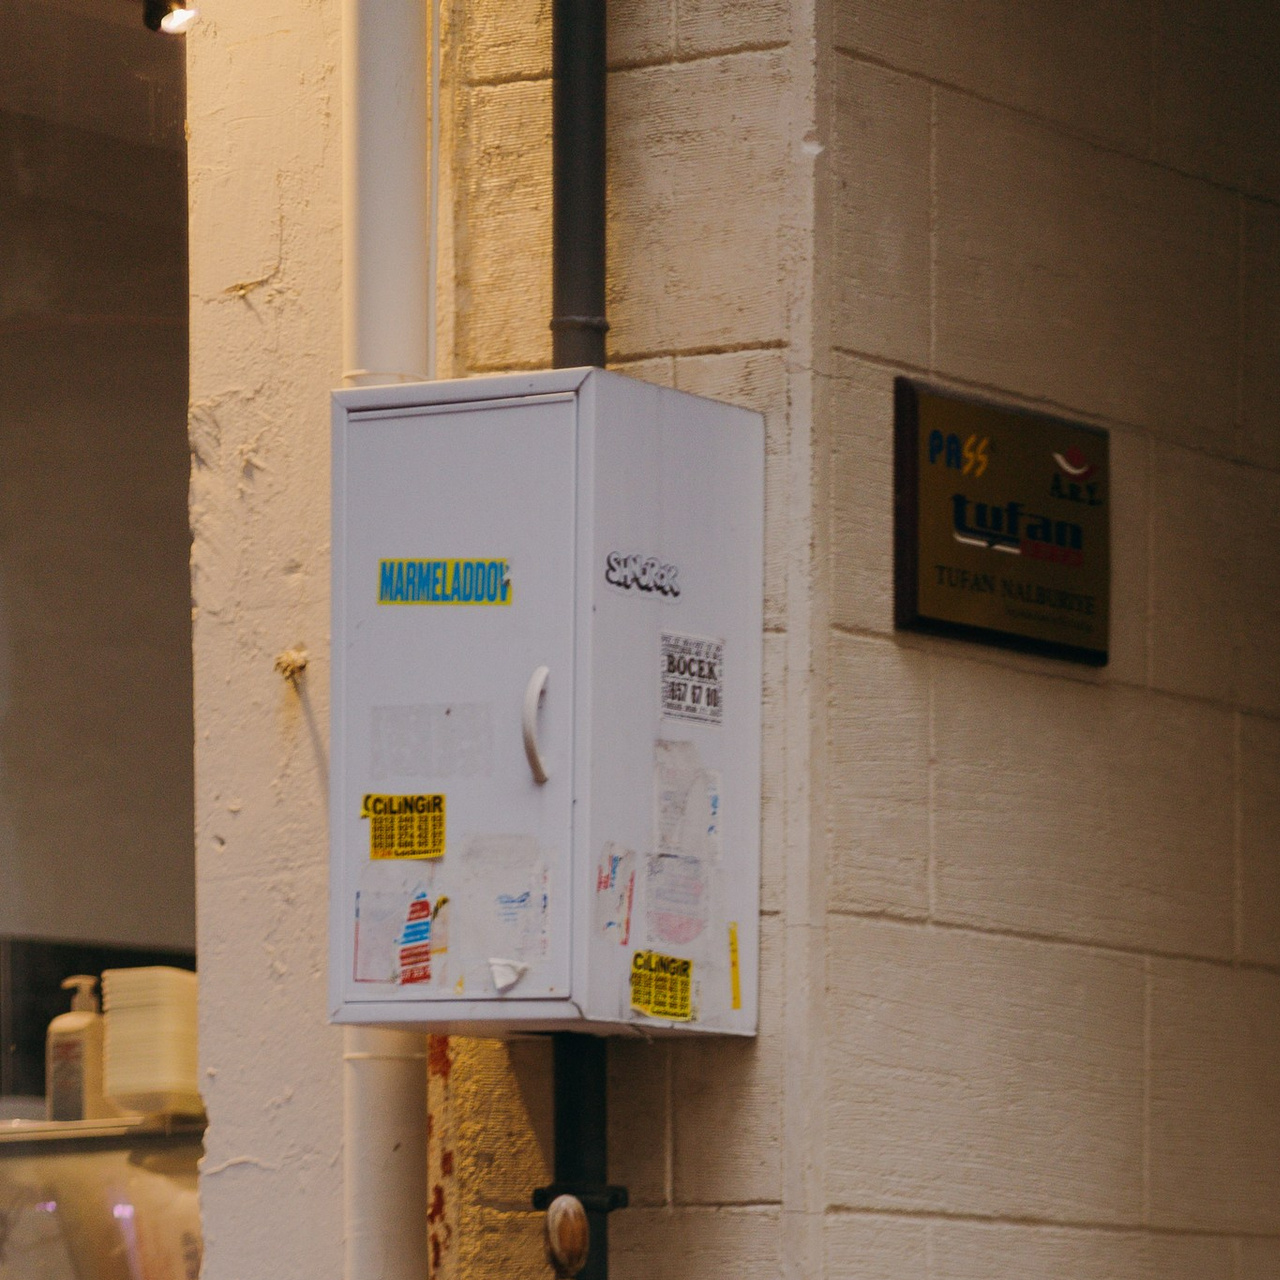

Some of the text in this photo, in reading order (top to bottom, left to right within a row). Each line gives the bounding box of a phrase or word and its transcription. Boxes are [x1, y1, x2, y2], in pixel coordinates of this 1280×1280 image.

[929, 429, 990, 478] PASS
[951, 494, 1083, 550] tufan
[380, 561, 509, 602] MARMELADDOV
